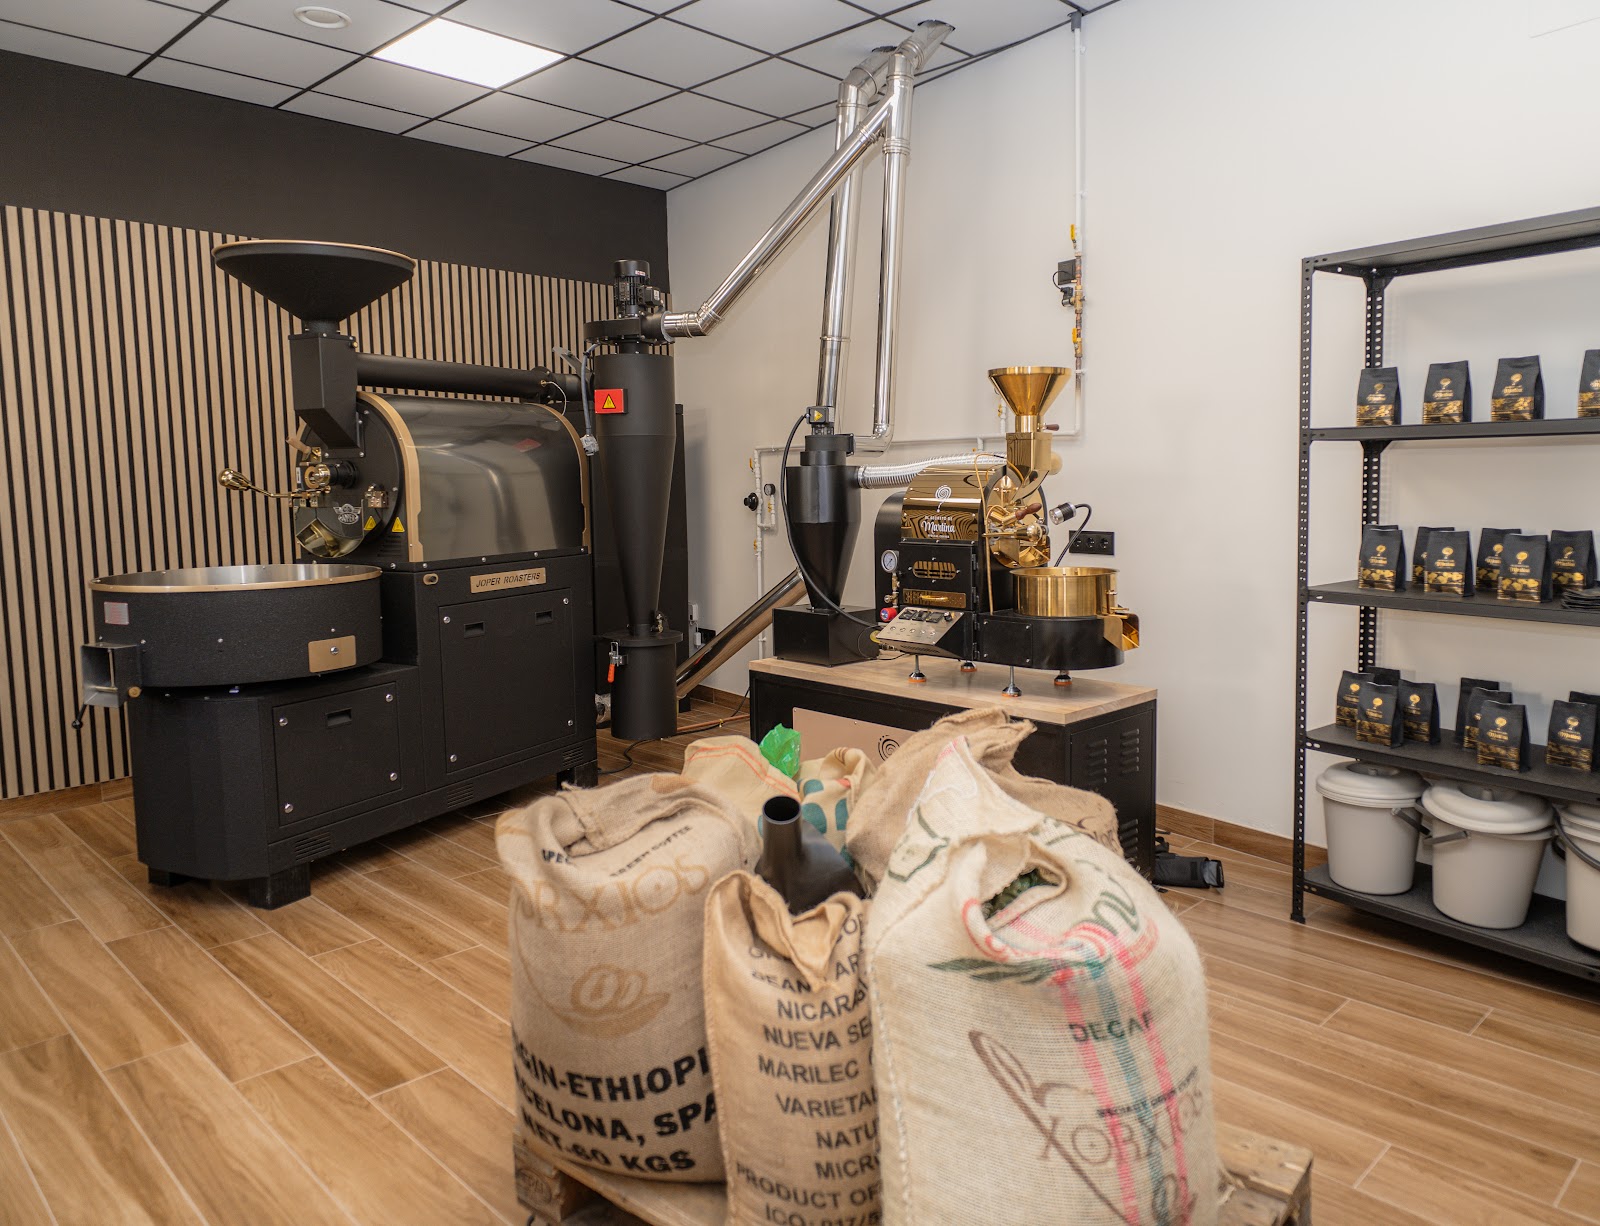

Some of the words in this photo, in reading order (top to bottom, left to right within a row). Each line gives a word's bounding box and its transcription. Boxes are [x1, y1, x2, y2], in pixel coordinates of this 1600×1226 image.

[921, 520, 955, 534] Martina
[476, 577, 500, 588] JOPER
[503, 572, 541, 584] ROASTERS
[763, 1024, 841, 1051] NUEVA
[1068, 1011, 1151, 1043] DECAF
[758, 1053, 859, 1084] MARILEC
[619, 1150, 696, 1173] KGS
[736, 1160, 841, 1209] PRODUCT
[850, 1180, 881, 1206] OF
